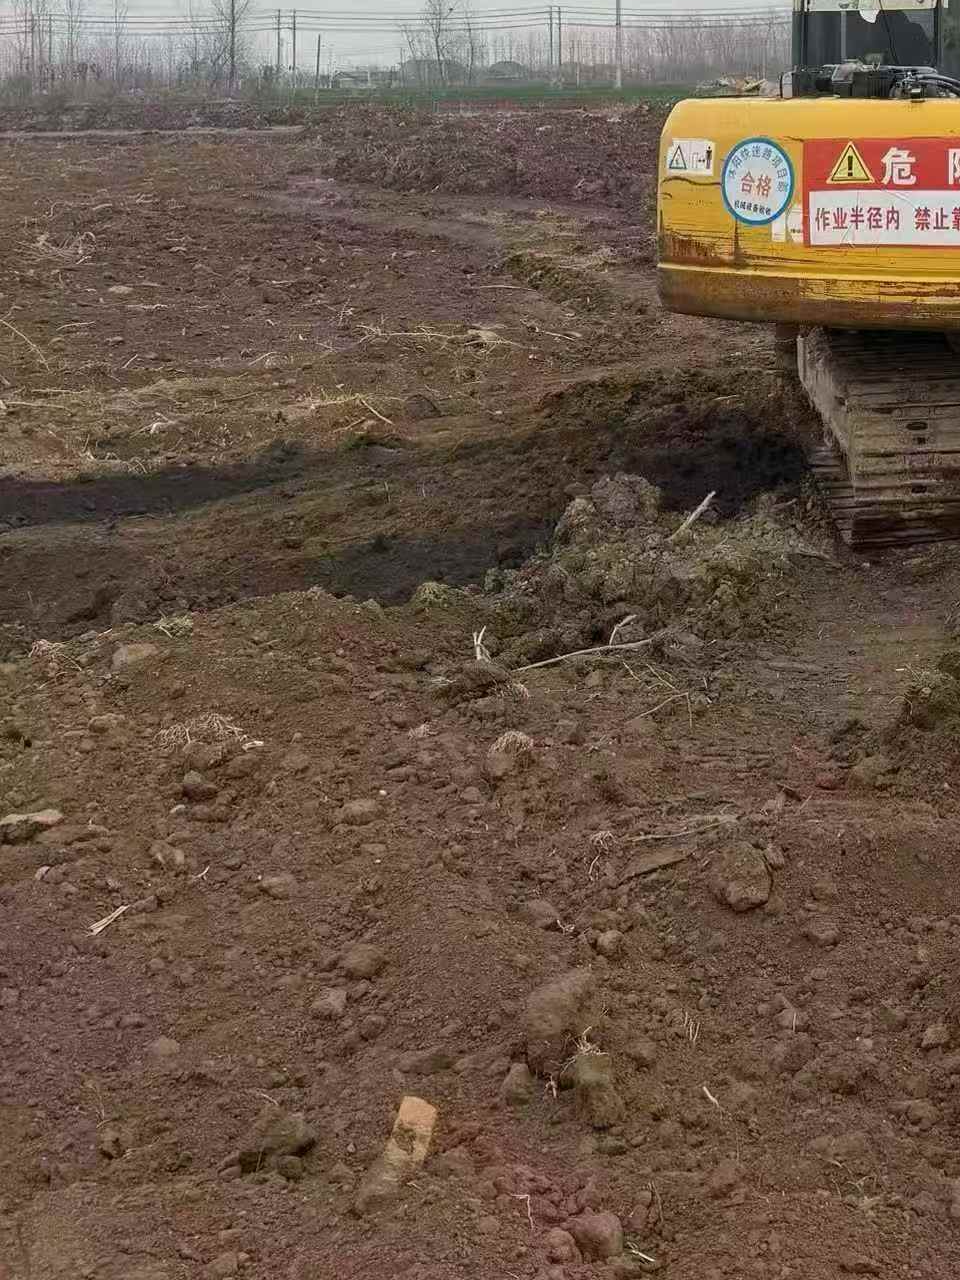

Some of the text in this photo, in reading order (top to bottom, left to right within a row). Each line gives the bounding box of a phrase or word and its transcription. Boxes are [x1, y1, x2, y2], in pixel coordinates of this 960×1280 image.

[741, 170, 772, 197] 合格
[815, 206, 900, 231] 作业半径内
